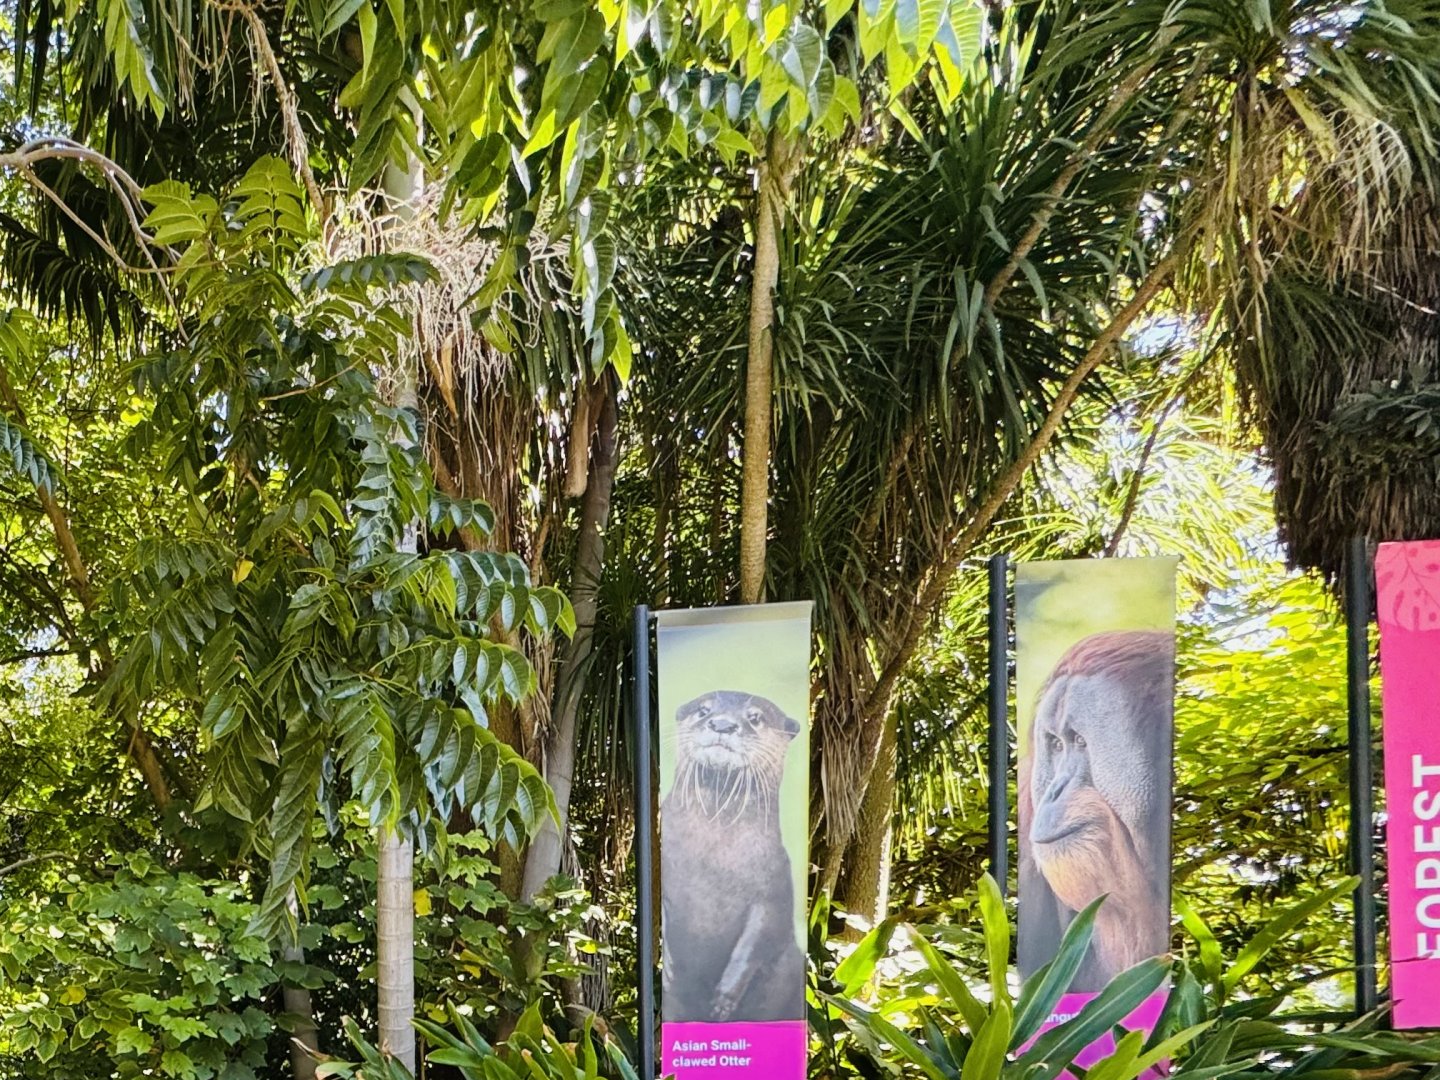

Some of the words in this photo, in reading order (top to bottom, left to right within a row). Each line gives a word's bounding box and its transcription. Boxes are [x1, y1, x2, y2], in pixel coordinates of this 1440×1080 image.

[672, 1040, 708, 1052] Asian
[710, 1038, 752, 1051] Small-
[672, 1055, 716, 1067] clawed
[719, 1055, 752, 1067] Otter
